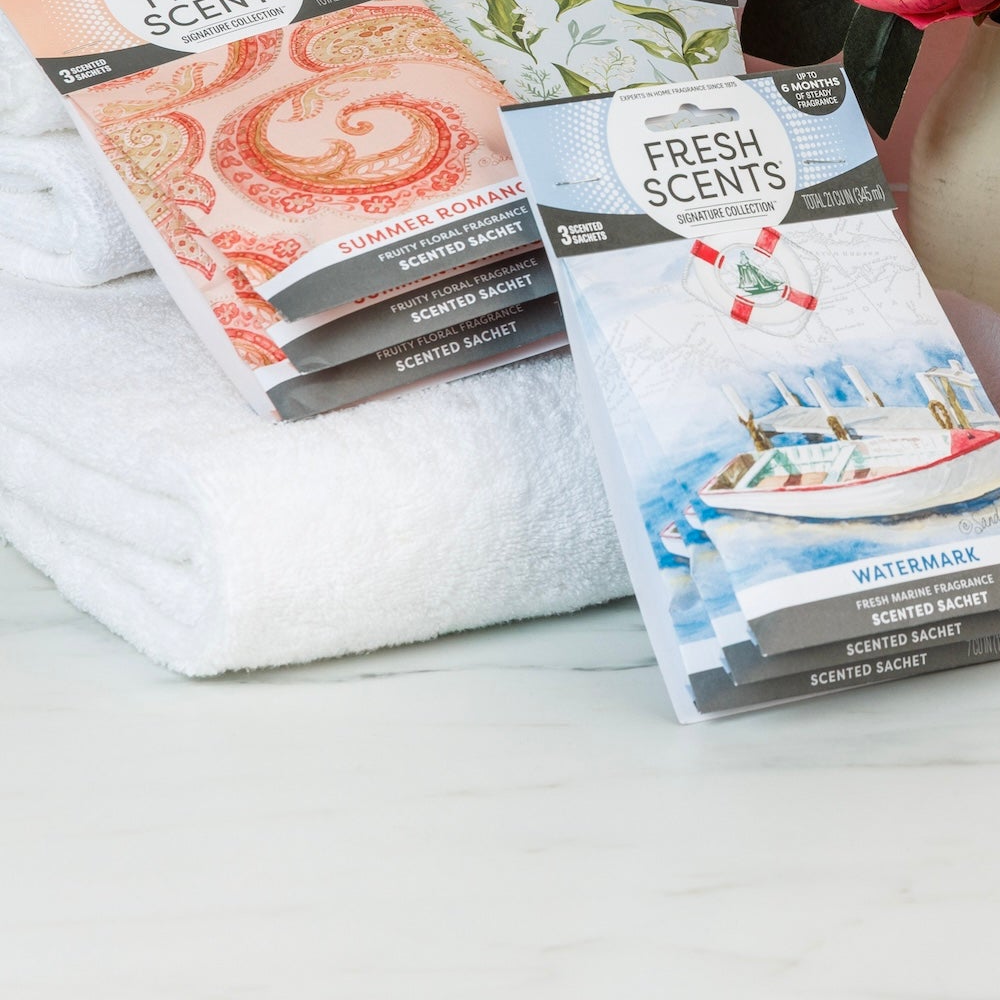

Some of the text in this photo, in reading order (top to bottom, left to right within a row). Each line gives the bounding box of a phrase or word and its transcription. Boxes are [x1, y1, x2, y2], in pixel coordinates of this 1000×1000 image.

[181, 22, 234, 44] SIGNATURE
[59, 69, 76, 84] 3
[71, 58, 107, 74] SCENTED
[75, 64, 112, 82] SACHETS
[795, 71, 818, 80] UP TO
[781, 77, 841, 93] 6 MONTHS
[795, 89, 832, 101] OF STEADY
[797, 96, 838, 109] FRAGRANCE
[643, 128, 763, 171] FRESH
[569, 221, 603, 234] SCENTED
[676, 208, 726, 226] SIGNATURE
[337, 213, 433, 255] SUMMER
[377, 205, 529, 262] FRUITY FLORAL FRAGRANCE
[557, 225, 572, 246] 3
[572, 230, 608, 244] SACHETS
[398, 221, 524, 271] SCENTED SACHET
[390, 258, 539, 314] FRUITY FLORAL FRAGRANCE
[410, 274, 534, 324] SCENTED SACHET
[851, 547, 980, 584] WATERMARK
[855, 573, 995, 610] FRESH MARINE FRAGRANCE
[871, 591, 989, 626] SCENTED SACHET
[846, 622, 962, 656] SCENTED SACHET
[811, 653, 927, 686] SCENTED SACHET
